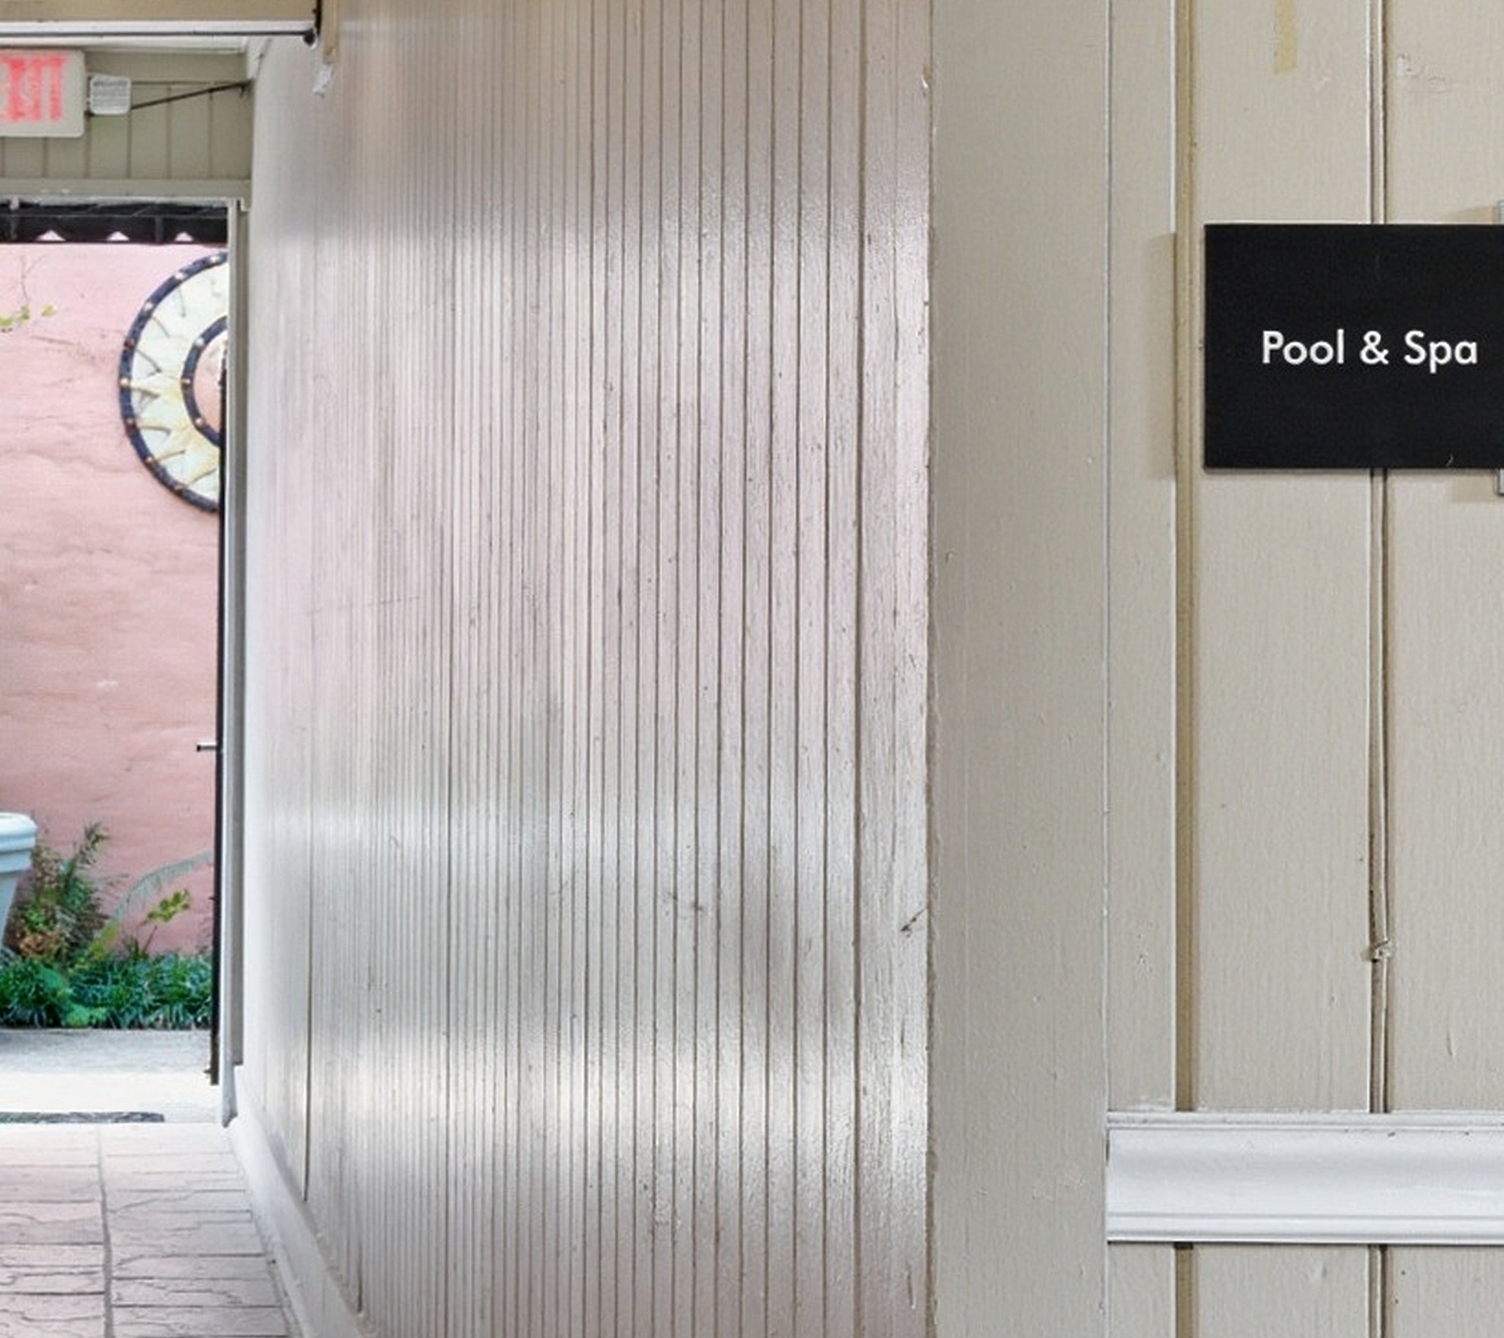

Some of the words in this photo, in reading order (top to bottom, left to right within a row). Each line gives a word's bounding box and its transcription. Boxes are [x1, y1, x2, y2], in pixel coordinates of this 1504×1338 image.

[1262, 328, 1345, 365] Pool
[1359, 330, 1389, 365] &
[1403, 329, 1478, 374] Spa
